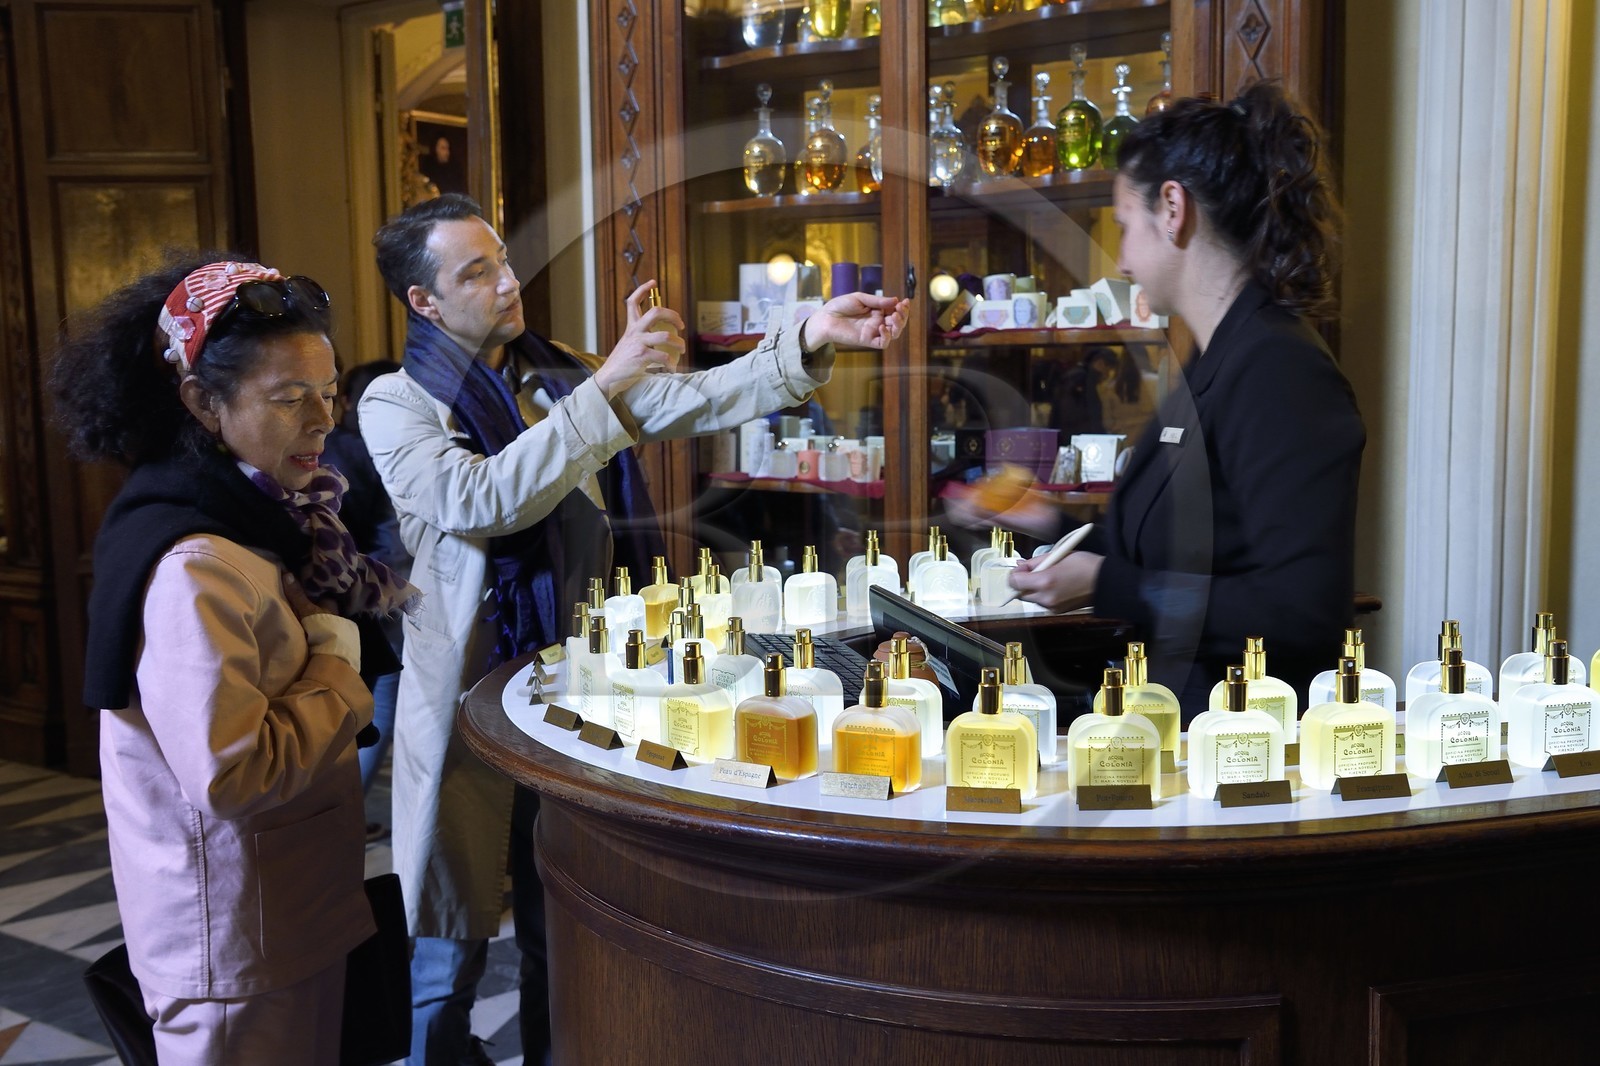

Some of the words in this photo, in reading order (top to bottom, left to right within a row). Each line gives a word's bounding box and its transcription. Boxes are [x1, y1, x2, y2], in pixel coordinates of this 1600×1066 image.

[674, 720, 692, 730] COLONIA
[1553, 726, 1581, 734] COLONIA
[1450, 736, 1479, 744] COLONIA
[1344, 748, 1373, 756] COLONIA
[971, 757, 1004, 765] COLONIA
[1242, 792, 1270, 800] Sandalo
